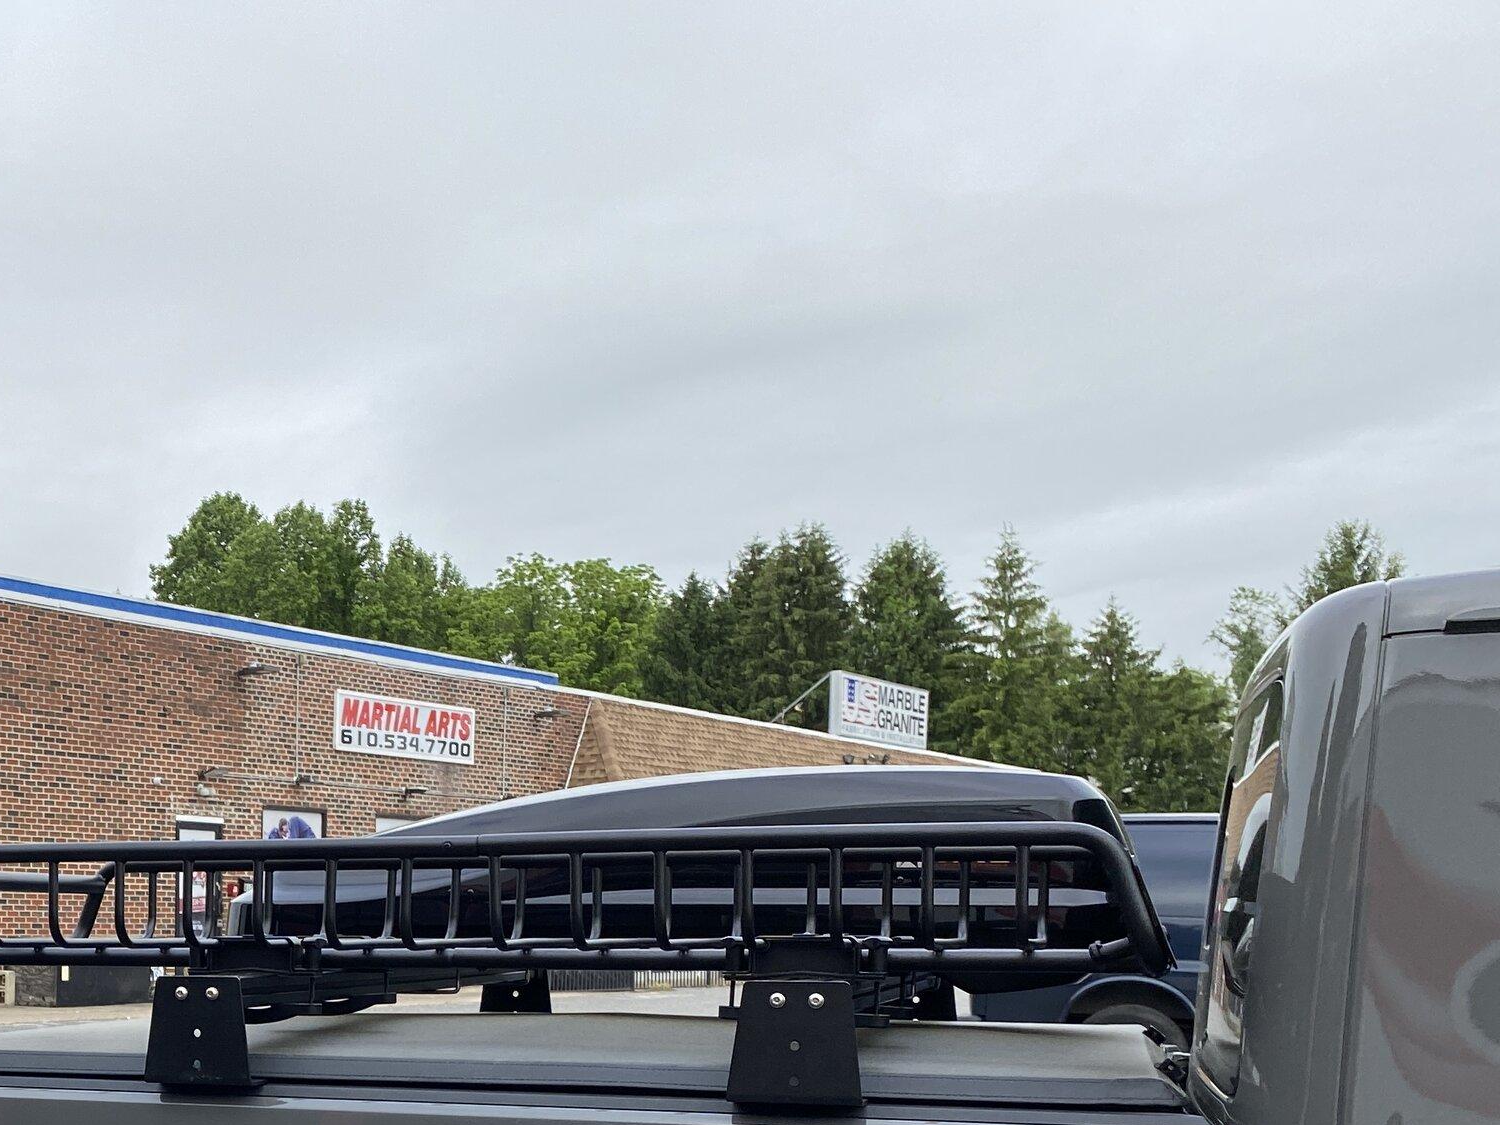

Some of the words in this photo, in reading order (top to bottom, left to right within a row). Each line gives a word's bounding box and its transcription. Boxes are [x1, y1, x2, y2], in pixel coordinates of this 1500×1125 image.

[878, 685, 926, 714] MARBLE
[341, 697, 421, 736] MARTIAL
[424, 709, 472, 741] ARTS
[877, 709, 925, 736] GRANITE
[341, 728, 471, 757] 610.534.7700
